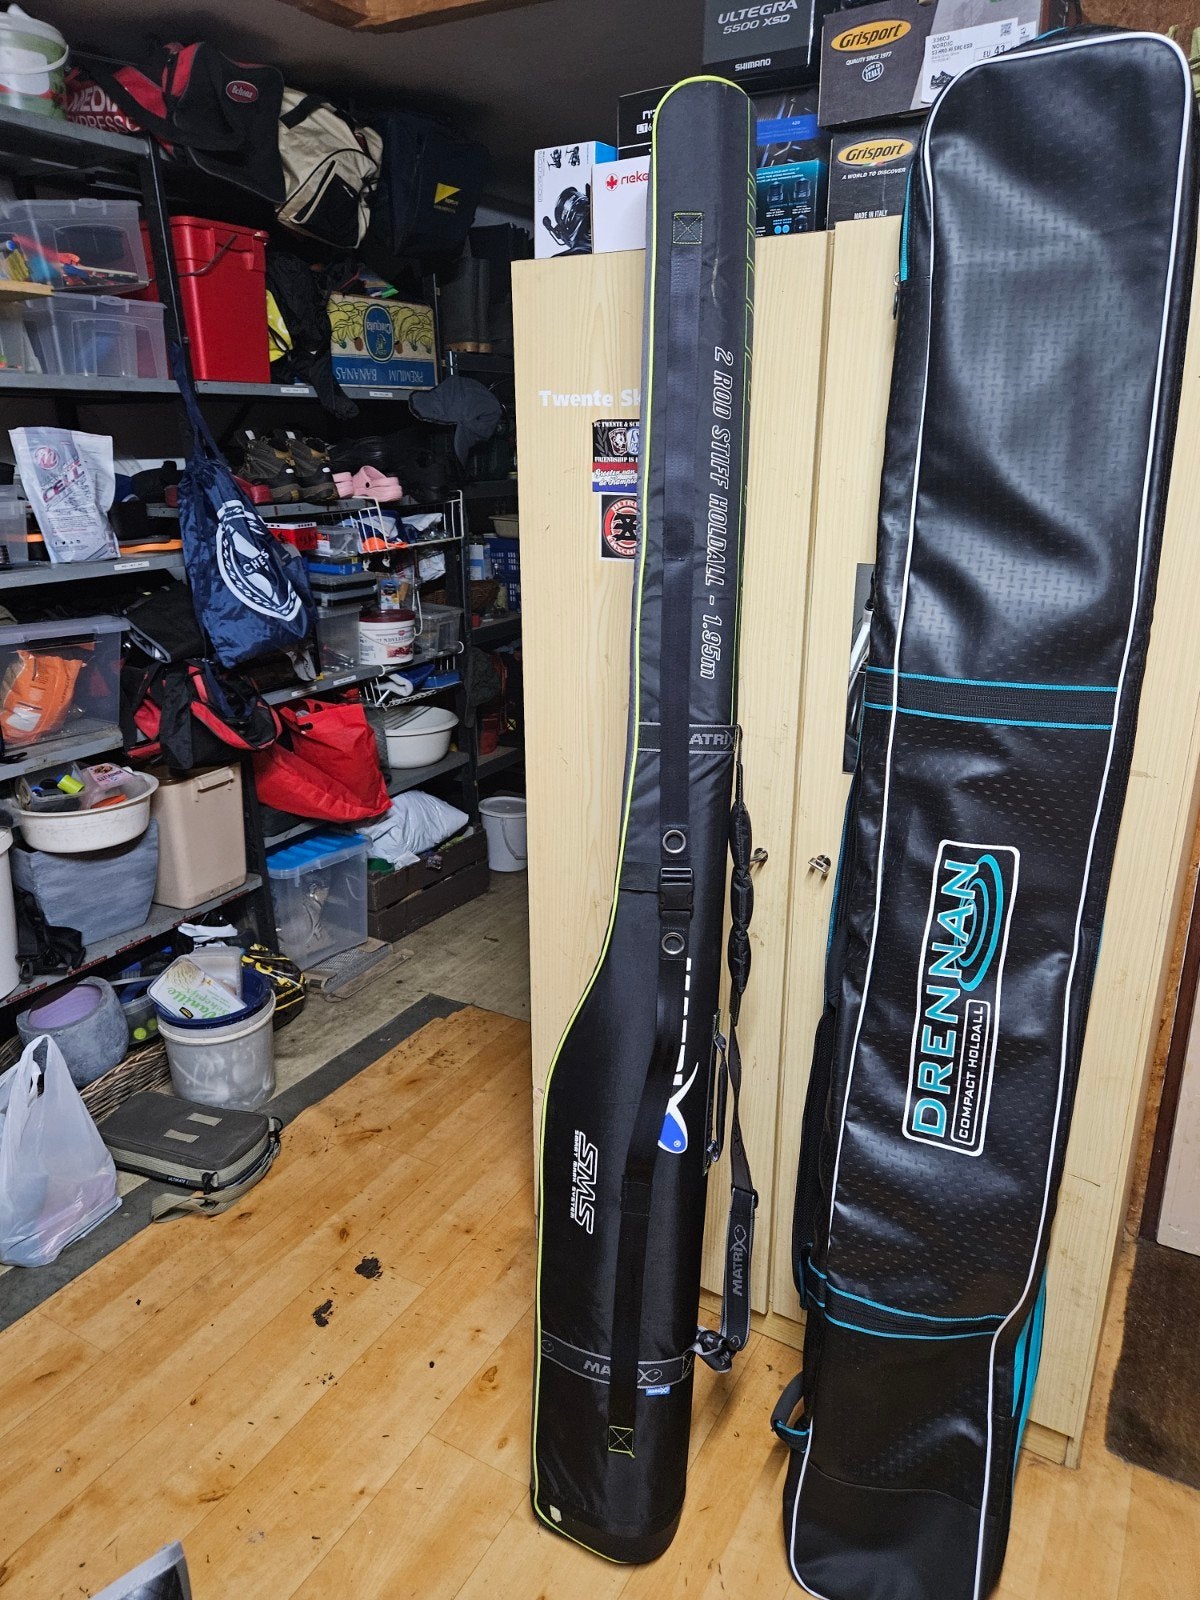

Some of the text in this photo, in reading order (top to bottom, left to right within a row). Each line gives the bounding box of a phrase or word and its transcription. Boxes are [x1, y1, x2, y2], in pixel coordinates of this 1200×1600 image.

[718, 0, 798, 24] ULTEGRA
[723, 14, 791, 34] 5500 XSD
[839, 23, 903, 48] Grisport
[735, 58, 772, 71] SHIMANO
[845, 57, 865, 66] QUALITY
[865, 68, 881, 80] ITALY
[846, 143, 904, 161] Grisport
[847, 171, 867, 179] WORLD
[877, 167, 907, 176] DISCOVER
[854, 211, 868, 219] MADE
[875, 209, 888, 217] ITALY
[714, 346, 734, 367] 2
[335, 366, 424, 383] PREMIUM BANANAS
[538, 389, 614, 407] Twente
[713, 370, 733, 420] ROD
[710, 424, 731, 490] STIFF
[706, 493, 728, 586] HOLDALL
[700, 614, 722, 680] 1.95m
[167, 987, 217, 1018] Vanille
[912, 859, 979, 1138] DRENNAN
[959, 1006, 983, 1140] COMPACT HOLDALL
[574, 1131, 598, 1235] SMS
